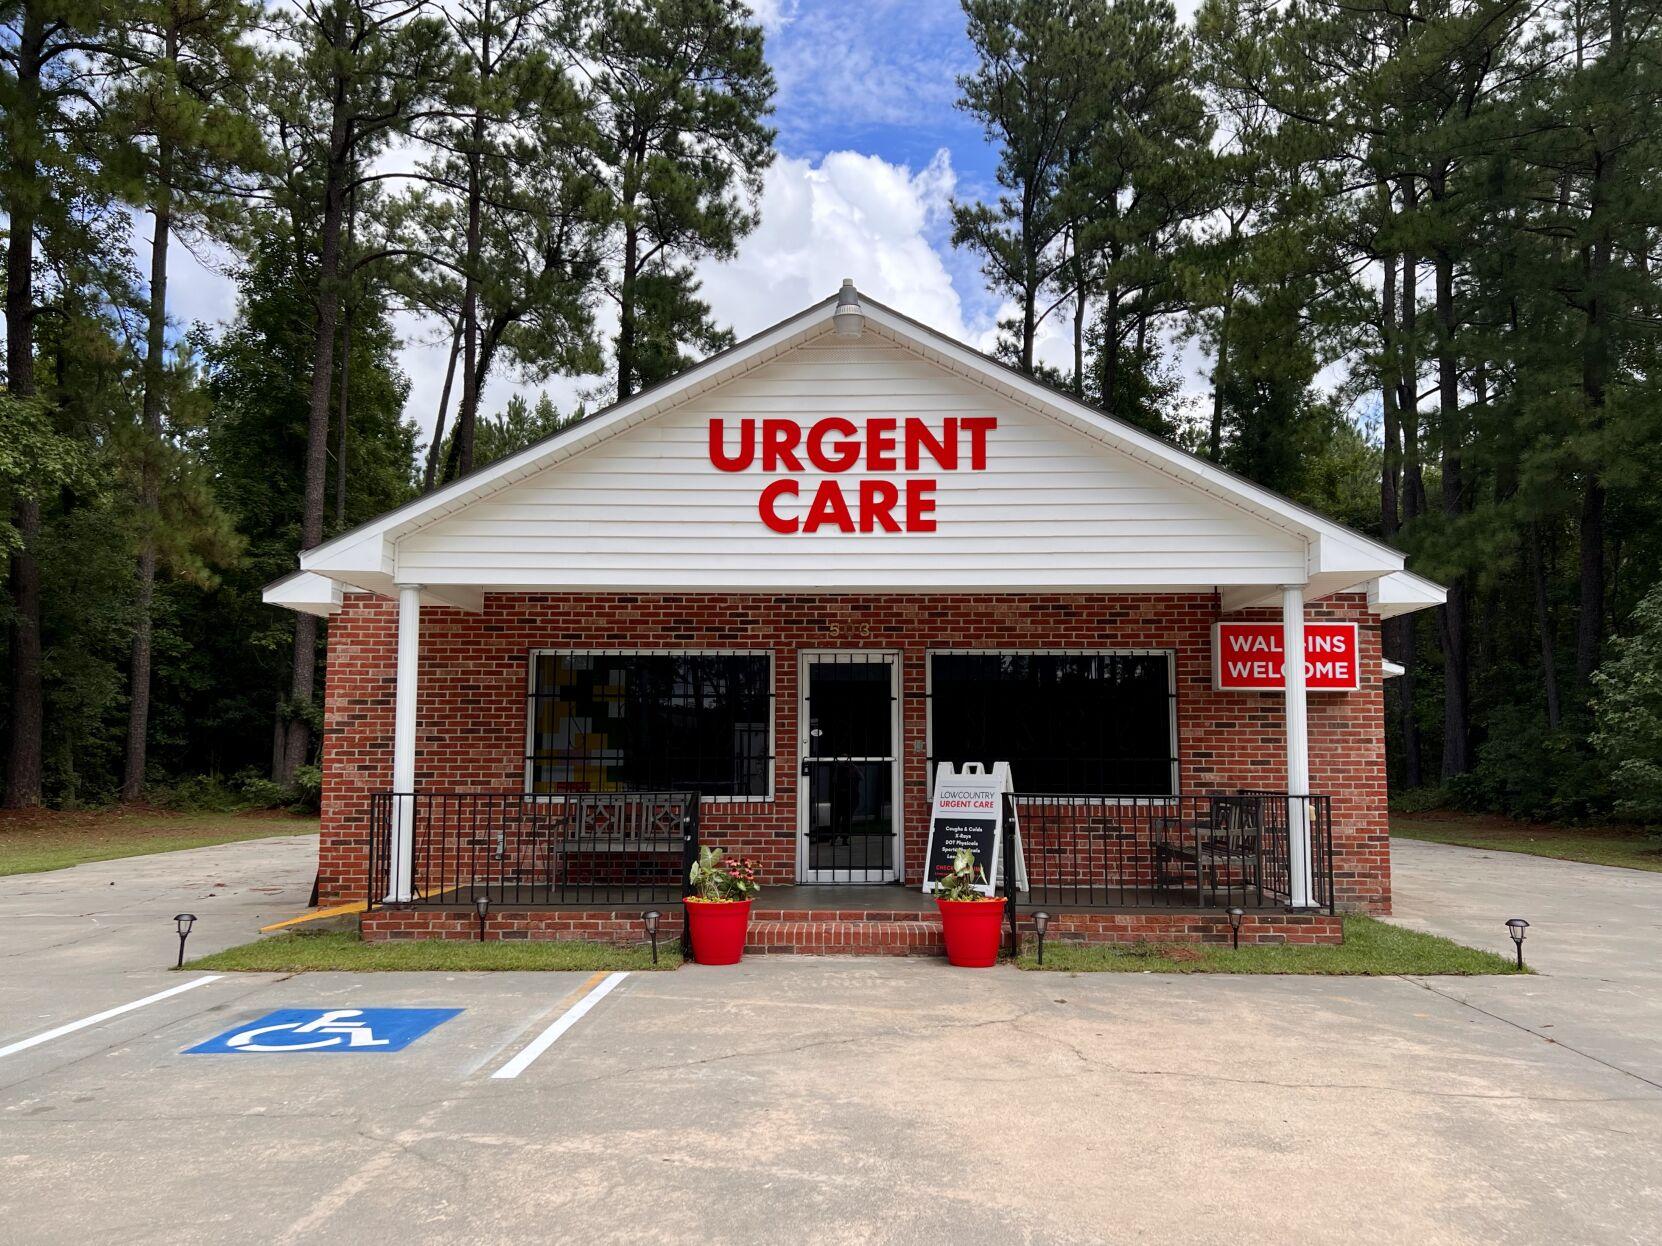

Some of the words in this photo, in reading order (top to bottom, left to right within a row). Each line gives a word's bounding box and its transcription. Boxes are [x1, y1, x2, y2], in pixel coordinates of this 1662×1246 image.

[709, 417, 997, 472] URGENT
[758, 479, 937, 533] CARE
[1229, 635, 1346, 653] WAL-INS
[940, 791, 995, 799] LOWCOUNTRY
[940, 800, 971, 808] URGENT
[973, 801, 994, 809] CARE
